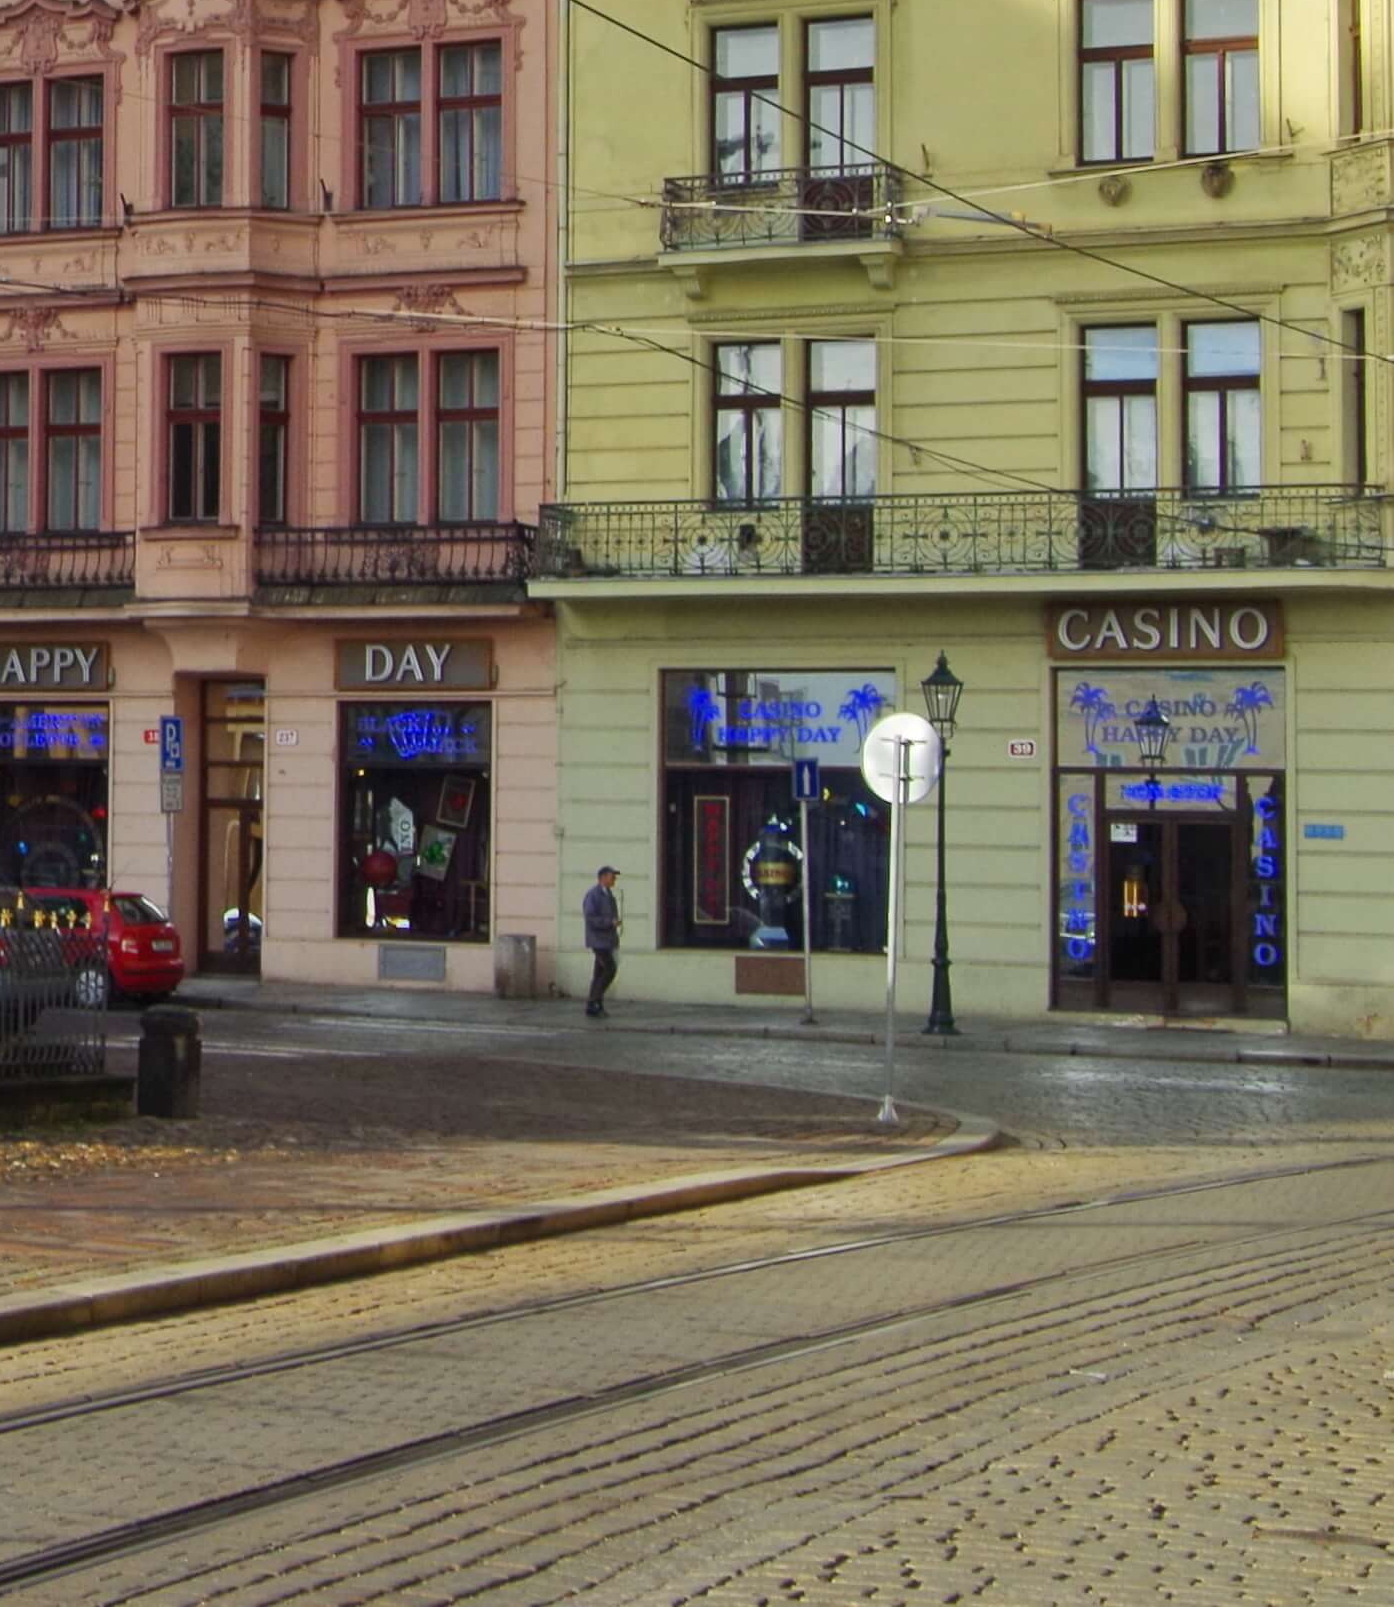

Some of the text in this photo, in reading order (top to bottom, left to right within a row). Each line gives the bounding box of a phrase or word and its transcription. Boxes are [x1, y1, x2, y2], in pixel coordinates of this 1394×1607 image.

[1058, 607, 1268, 650] CASINO
[365, 644, 451, 682] DAY
[737, 700, 821, 720] CASINO
[1124, 700, 1217, 718] CASINO
[166, 723, 177, 751] P
[717, 726, 841, 743] HAPPY DAY
[1101, 726, 1241, 744] HAPPY DAY
[1012, 743, 1032, 755] 39
[1067, 795, 1089, 960] CASINO
[1254, 797, 1278, 965] CASINO
